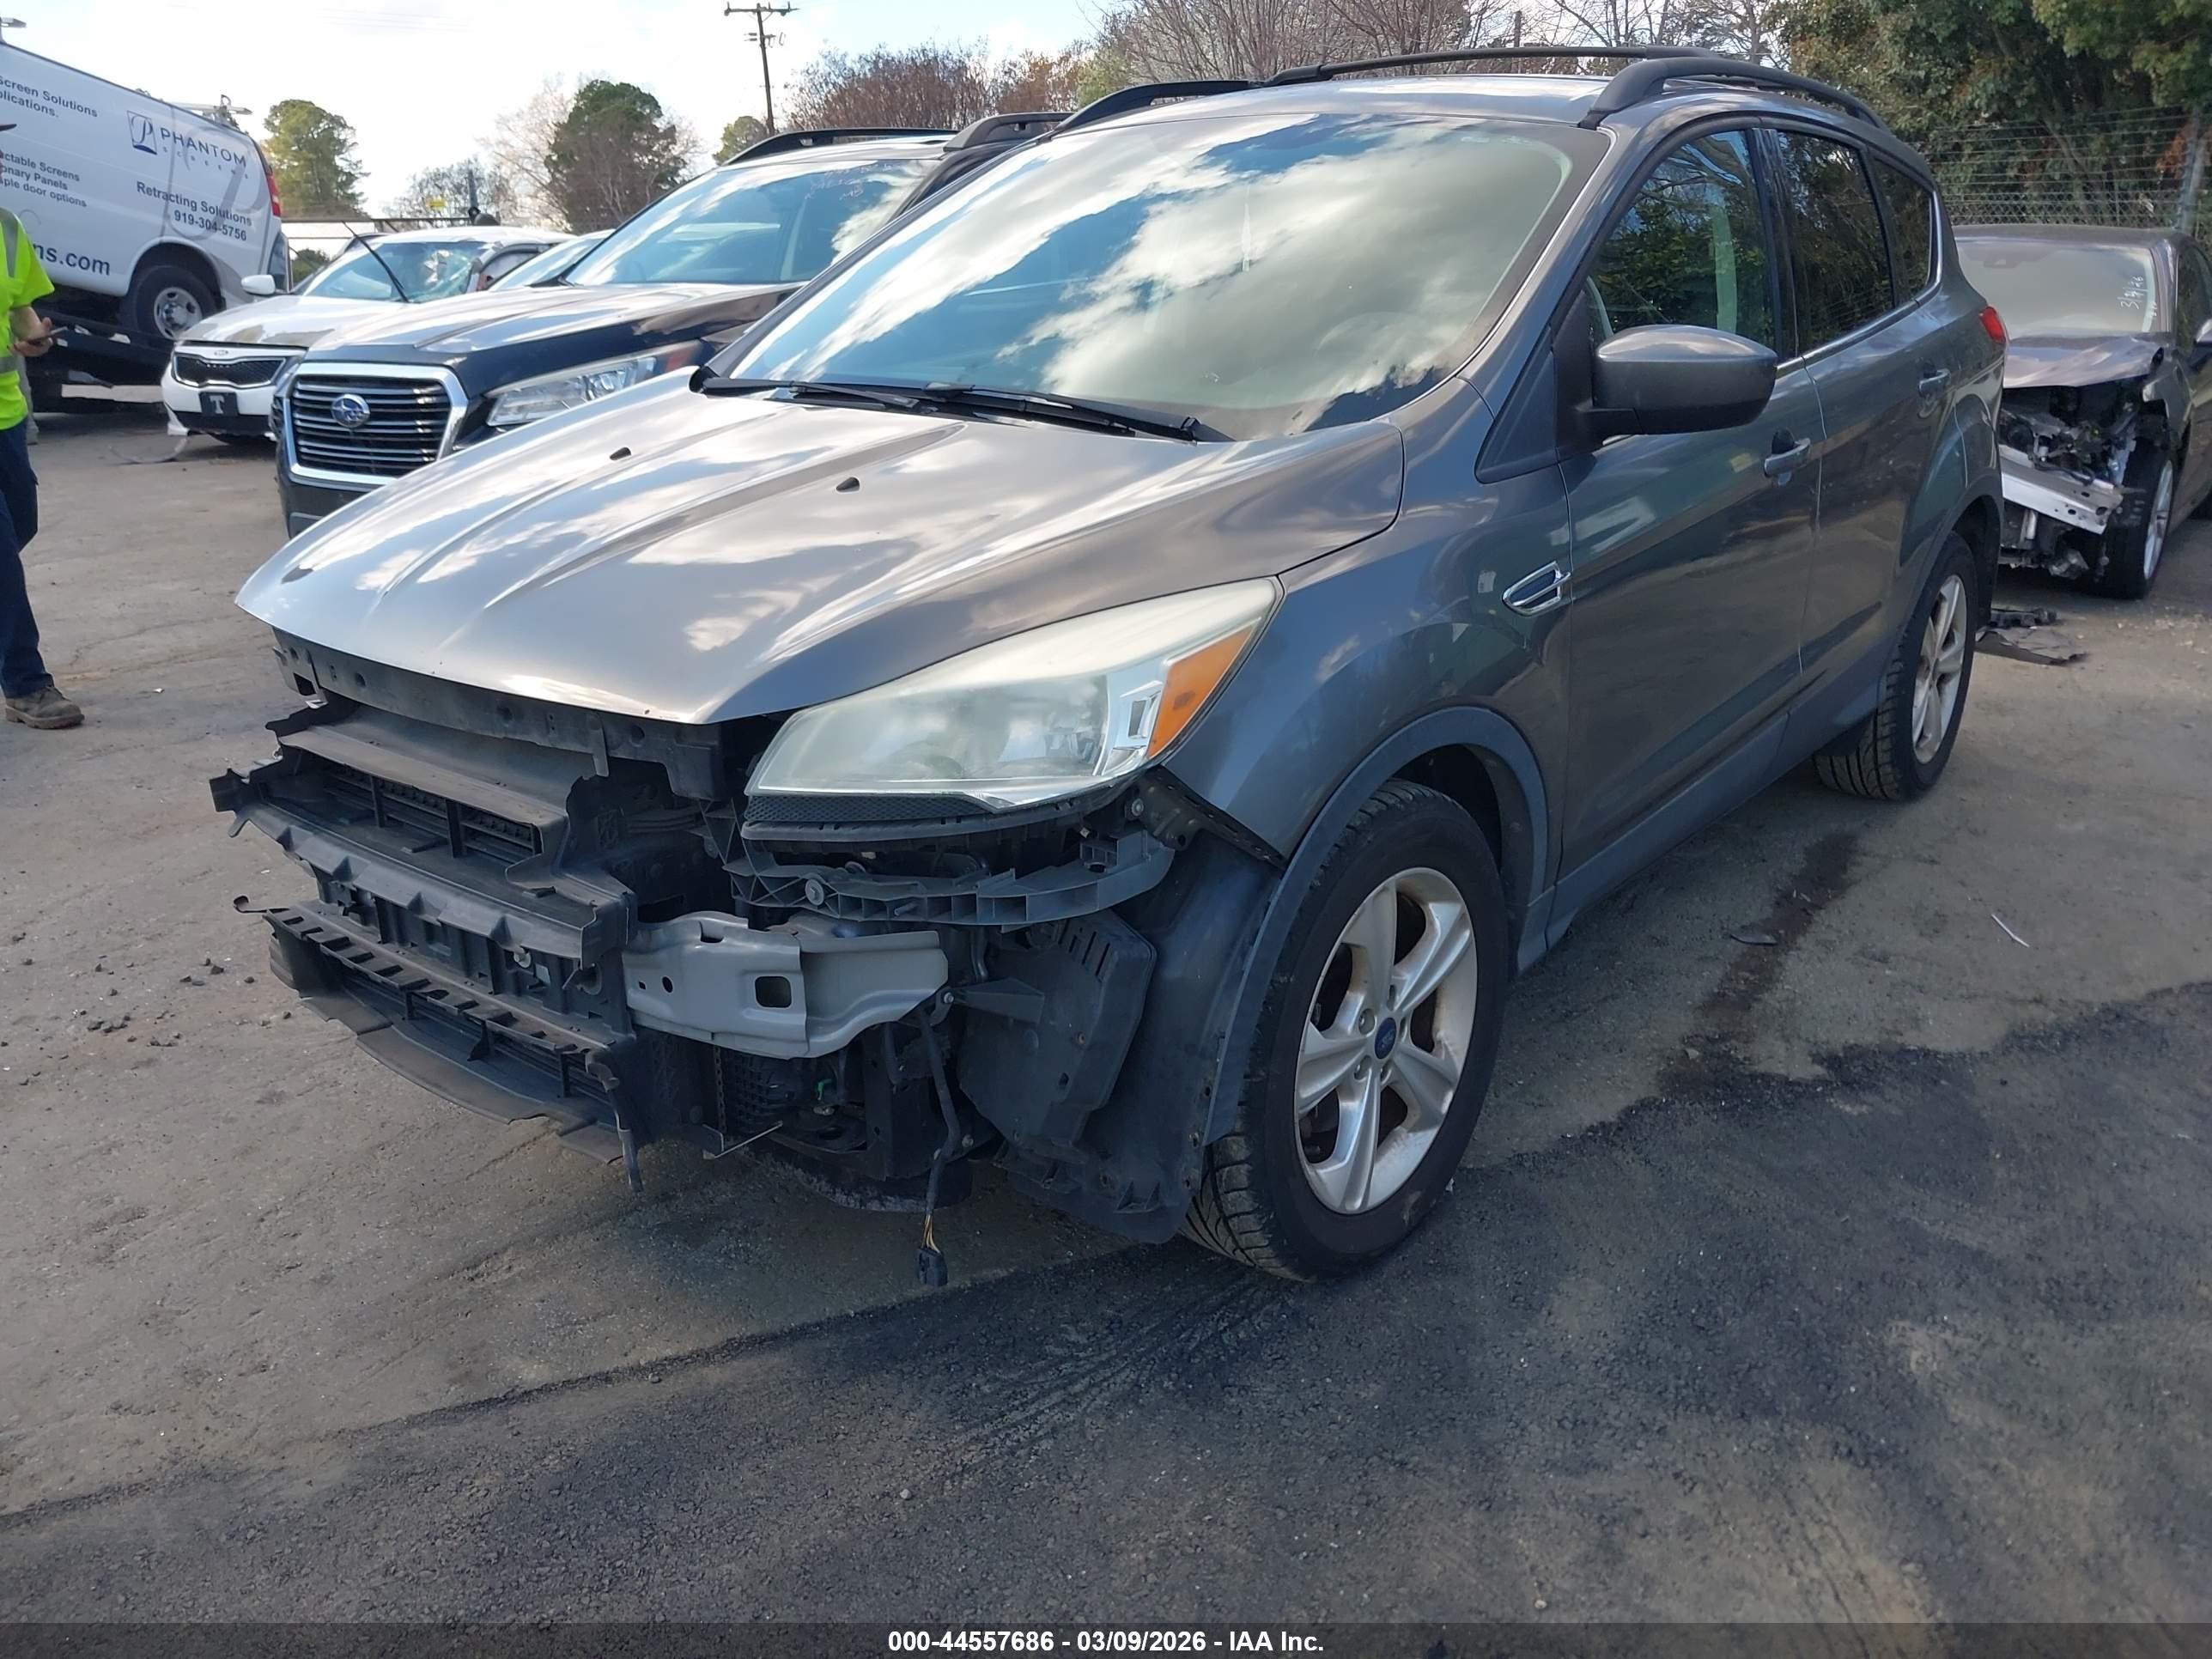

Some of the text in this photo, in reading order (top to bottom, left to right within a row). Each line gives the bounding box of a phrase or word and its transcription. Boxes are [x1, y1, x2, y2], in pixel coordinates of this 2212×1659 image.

[43, 90, 98, 118] Solutions
[160, 127, 246, 167] PHANTOM
[34, 173, 68, 191] Panels
[40, 161, 80, 181] Screens
[23, 183, 46, 197] door
[50, 191, 88, 207] options
[137, 180, 252, 227] Retracting Solutions
[174, 210, 246, 241] 919-304-5756
[209, 394, 225, 414] T
